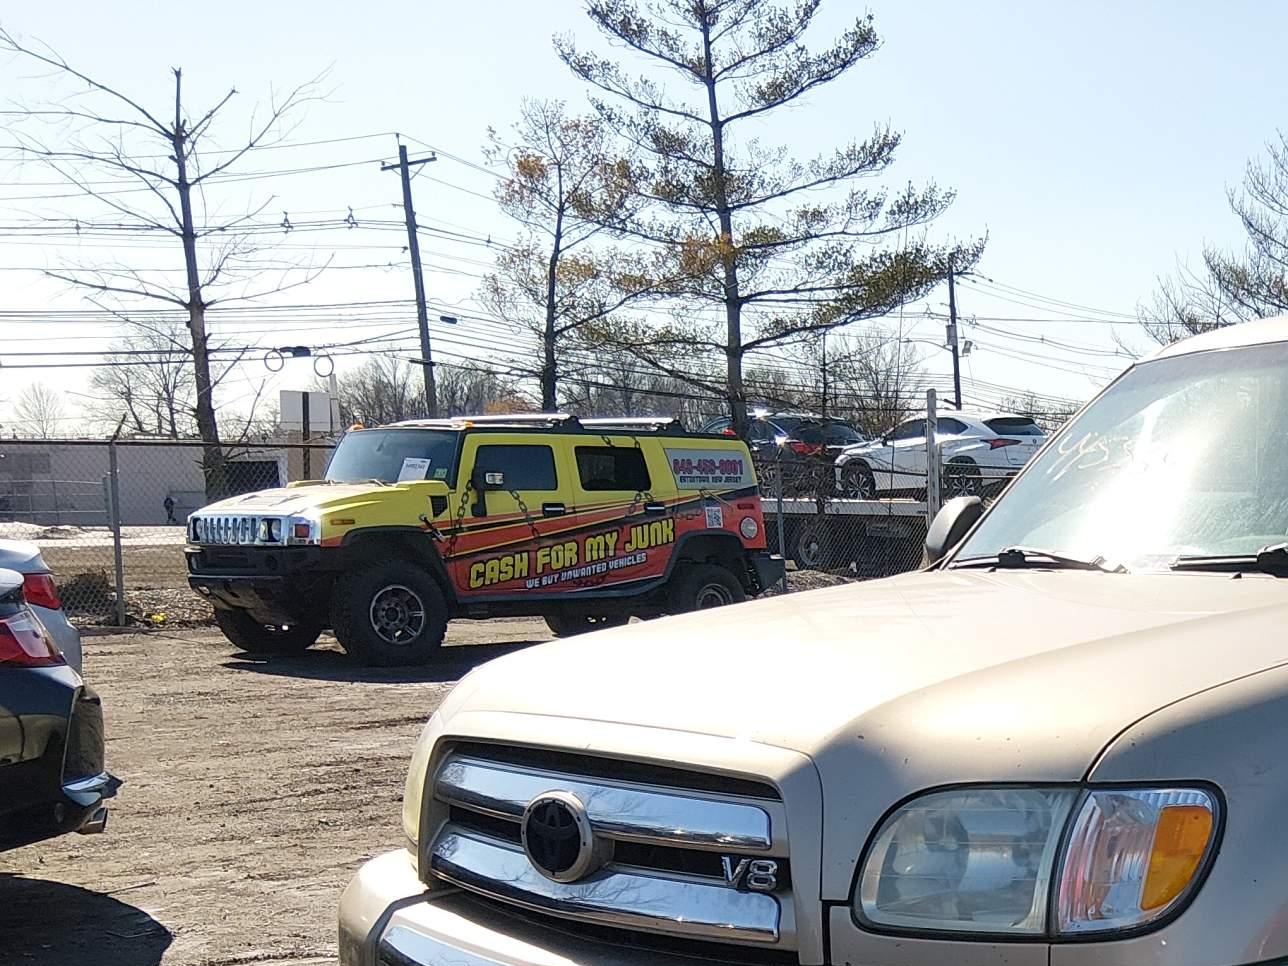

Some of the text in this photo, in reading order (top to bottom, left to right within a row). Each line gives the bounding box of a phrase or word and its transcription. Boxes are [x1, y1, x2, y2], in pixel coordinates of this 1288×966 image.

[724, 476, 742, 484] JERSEY
[468, 517, 676, 589] CASH FOR MY JUNK
[526, 552, 647, 588] WE BUY UNWANTED VEHICLES
[720, 855, 779, 891] V8
